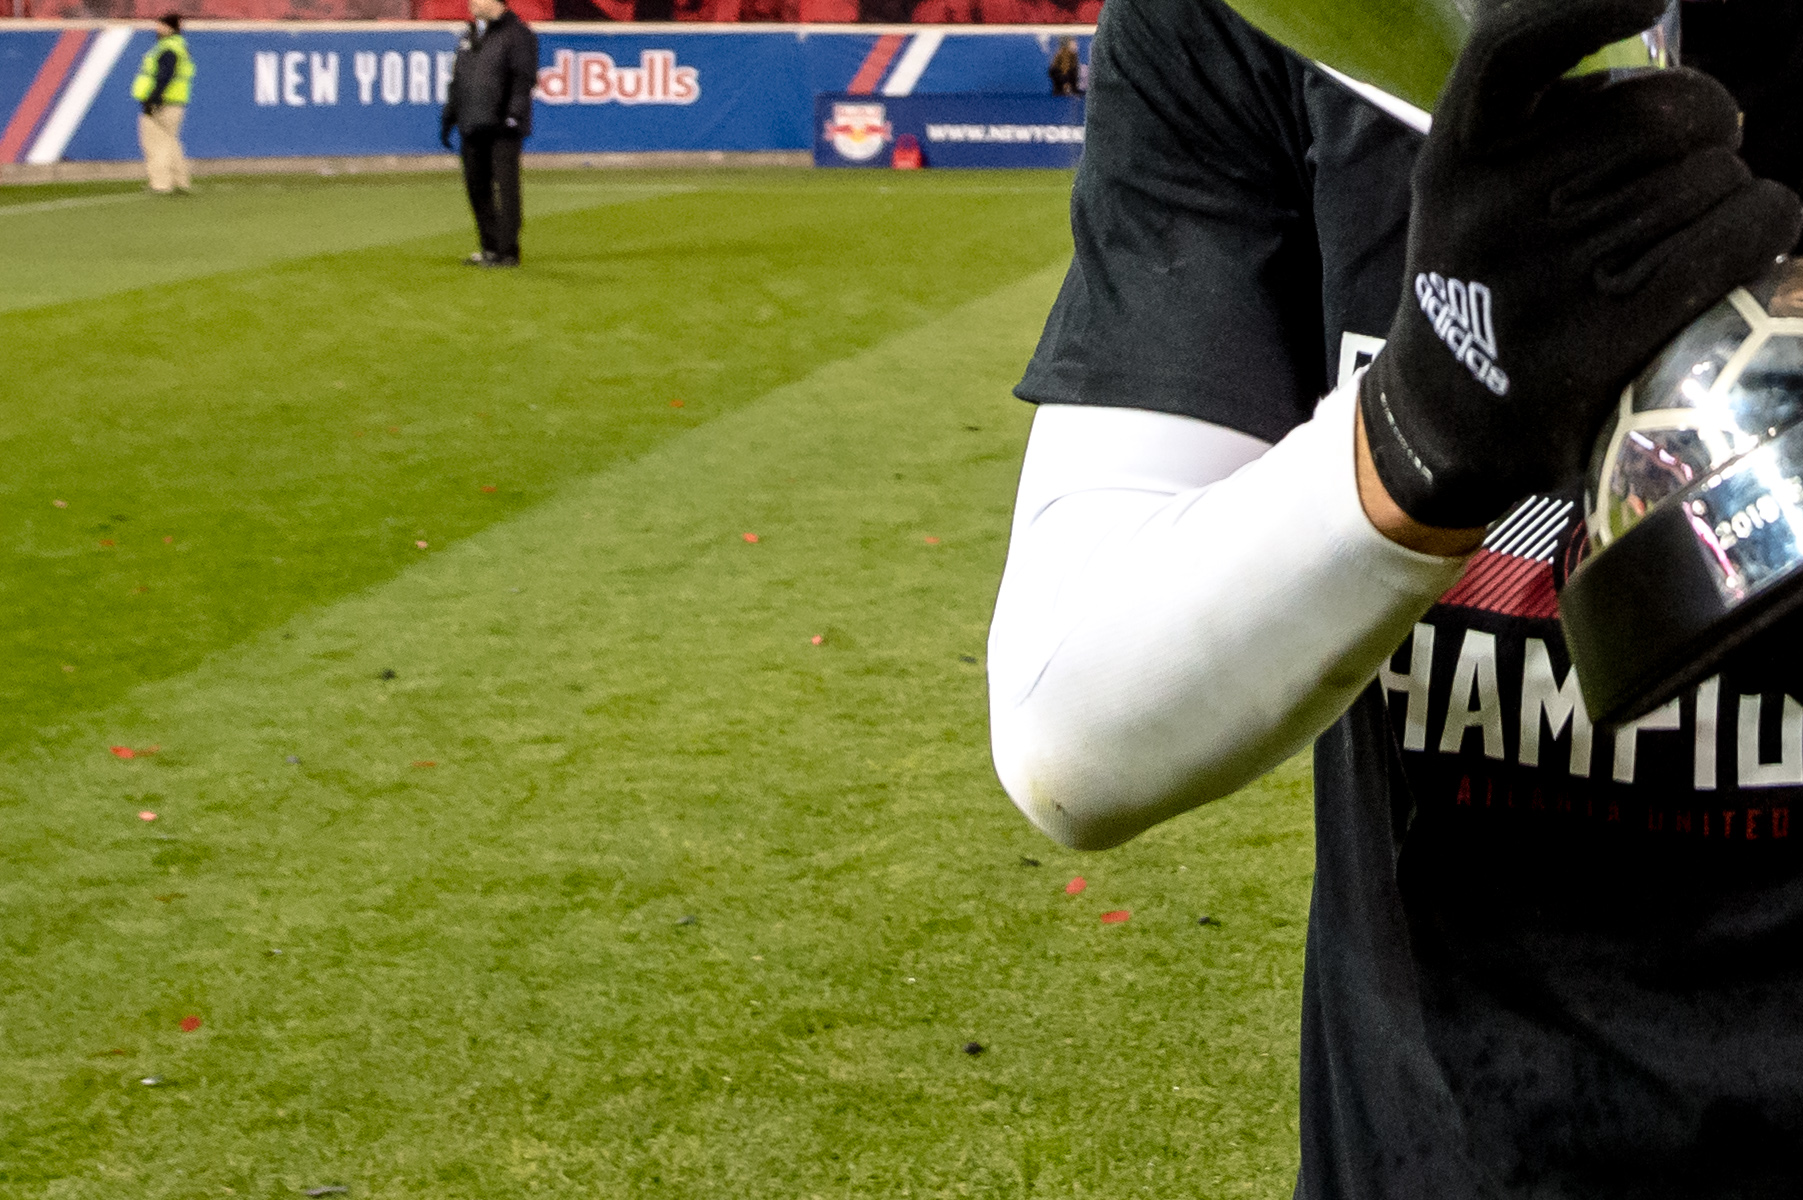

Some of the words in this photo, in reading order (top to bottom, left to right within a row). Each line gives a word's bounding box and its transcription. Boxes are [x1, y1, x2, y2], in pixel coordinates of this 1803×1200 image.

[254, 51, 338, 104] NEW
[580, 49, 699, 103] Bulls
[1415, 272, 1510, 396] adidas
[1648, 801, 1793, 842] UNITED
